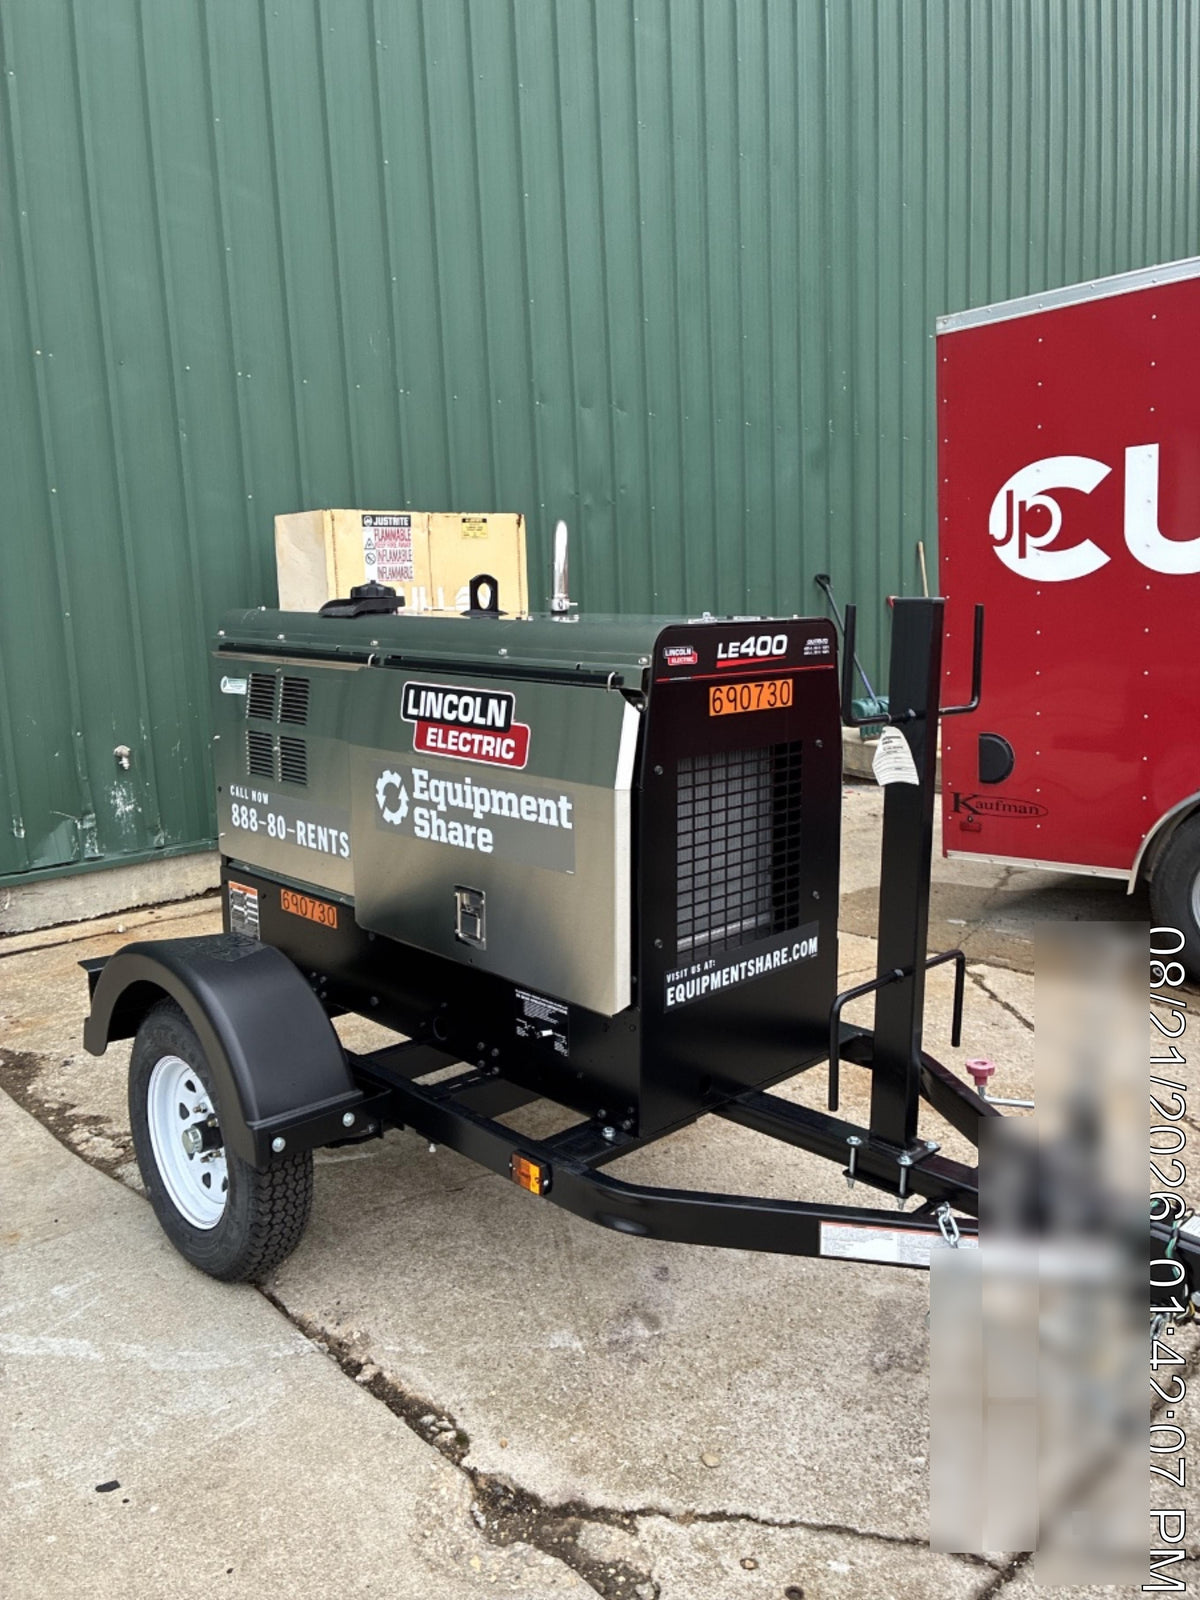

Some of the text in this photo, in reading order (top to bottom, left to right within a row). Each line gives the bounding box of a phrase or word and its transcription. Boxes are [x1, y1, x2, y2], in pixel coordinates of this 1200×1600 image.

[373, 517, 409, 526] JUSTRITE
[374, 528, 411, 541] FLAMMABLE
[717, 635, 788, 659] LE400
[407, 689, 507, 728] LINCOLN
[712, 681, 790, 713] 690730
[426, 728, 515, 760] ELECTRIC
[230, 785, 269, 805] CALL NOW
[411, 768, 573, 830] Equipment
[950, 791, 1040, 816] Kaufman
[231, 803, 350, 858] 888-80-RENTS
[413, 806, 494, 854] Share
[283, 891, 335, 926] 690730
[666, 959, 716, 983] VISIT US AT:
[666, 936, 818, 1007] EQUIPMENTSHARE.COM
